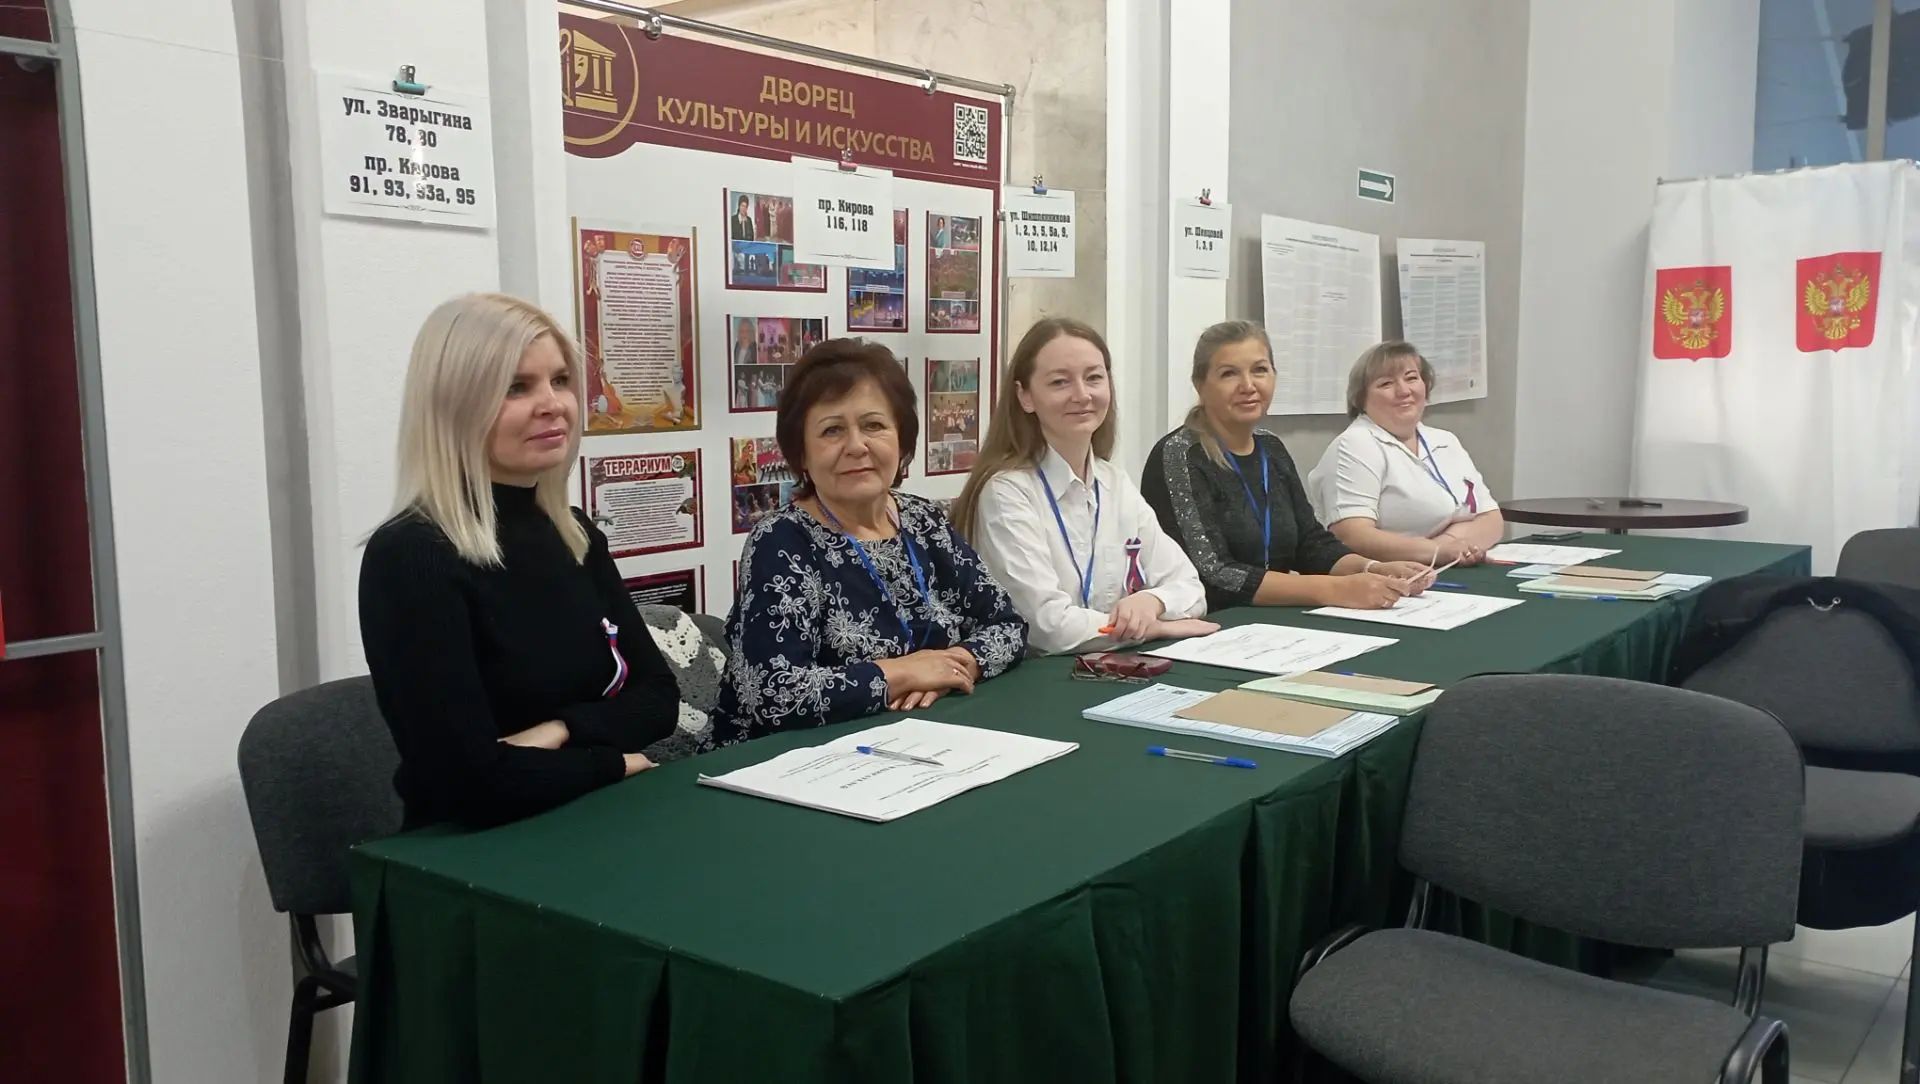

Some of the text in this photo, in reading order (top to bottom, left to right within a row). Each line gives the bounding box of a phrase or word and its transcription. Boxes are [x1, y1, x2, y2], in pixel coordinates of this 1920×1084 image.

[759, 75, 855, 119] ДВОРЕЦ
[342, 97, 472, 130] ул. Зварыгина
[385, 124, 412, 146] 78,
[657, 95, 935, 164] КУЛЬТУРЫ И ИСКУССТВА
[364, 155, 460, 181] пр. Кирова
[350, 175, 378, 196] 91,
[384, 179, 410, 199] 93,
[456, 188, 476, 205] 95
[818, 199, 874, 216] пр. Кирова
[827, 215, 868, 232] 116, 118
[604, 456, 672, 477] ТЕРРАРИУМ
